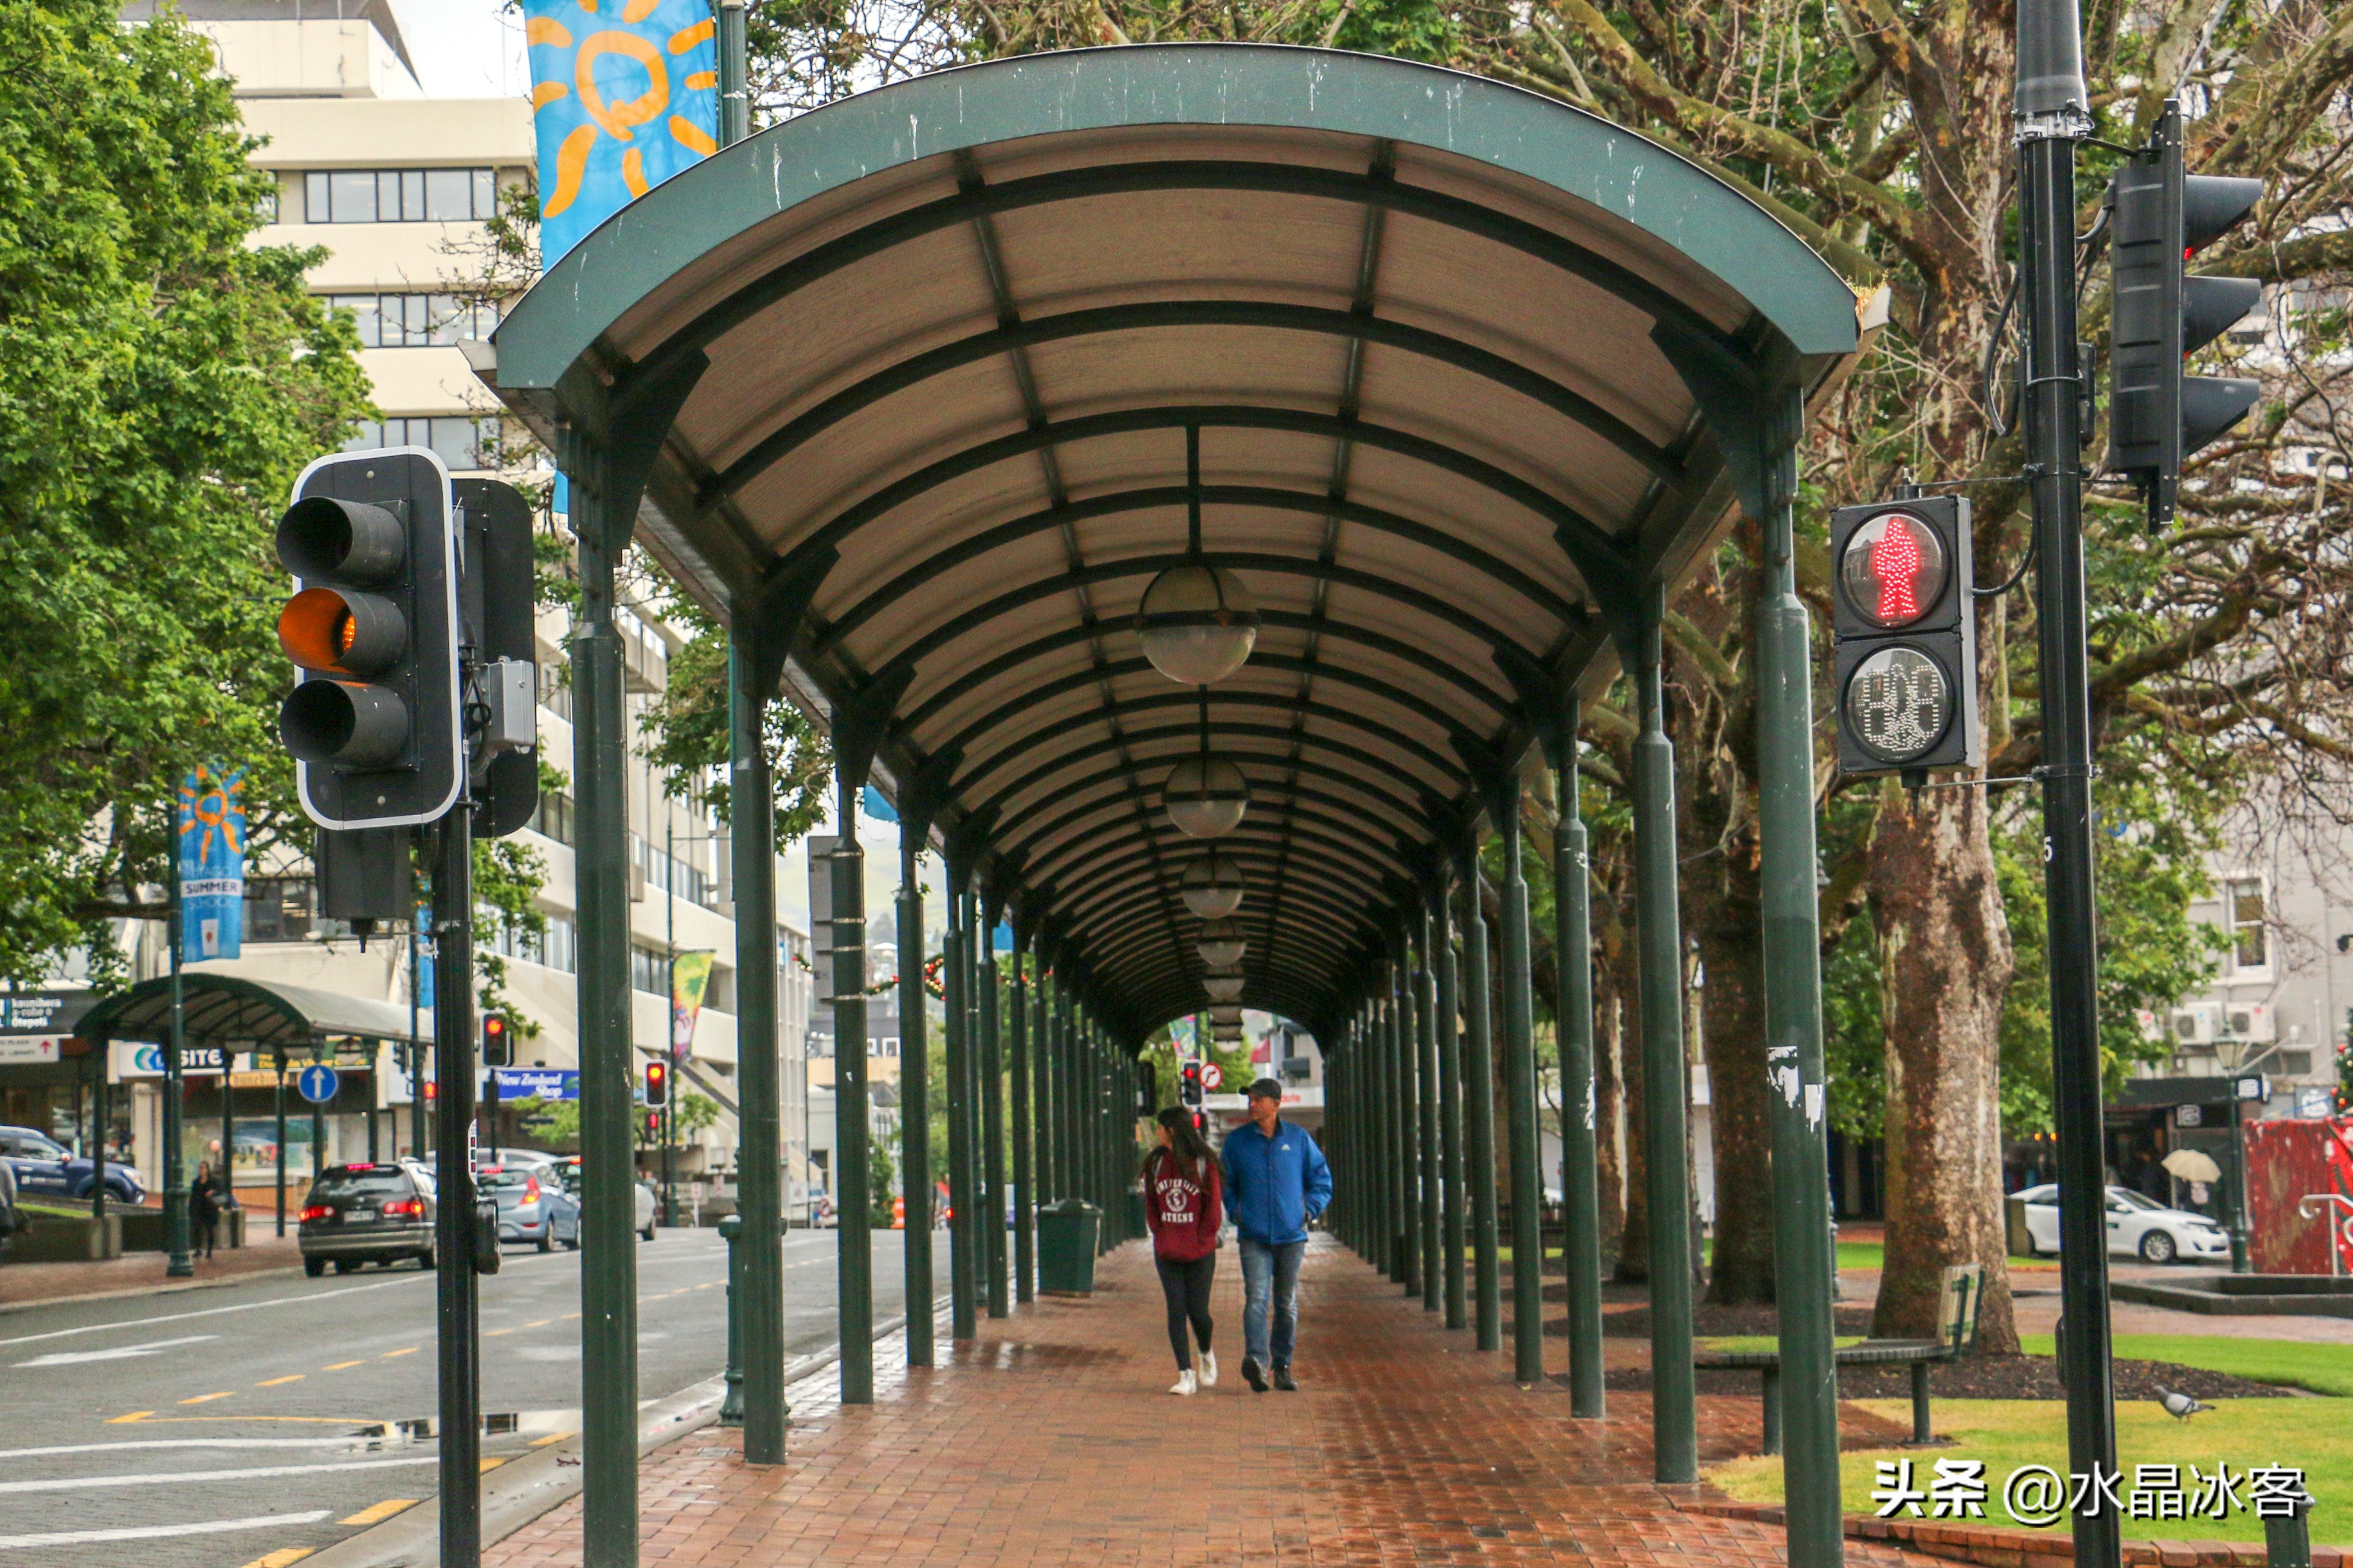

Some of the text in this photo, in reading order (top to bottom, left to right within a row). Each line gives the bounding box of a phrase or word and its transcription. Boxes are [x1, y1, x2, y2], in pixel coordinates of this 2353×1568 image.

[186, 882, 237, 894] SUMMER
[495, 1071, 563, 1087] New Zealand
[535, 1084, 563, 1098] Shop
[1161, 1211, 1194, 1223] ATHENS
